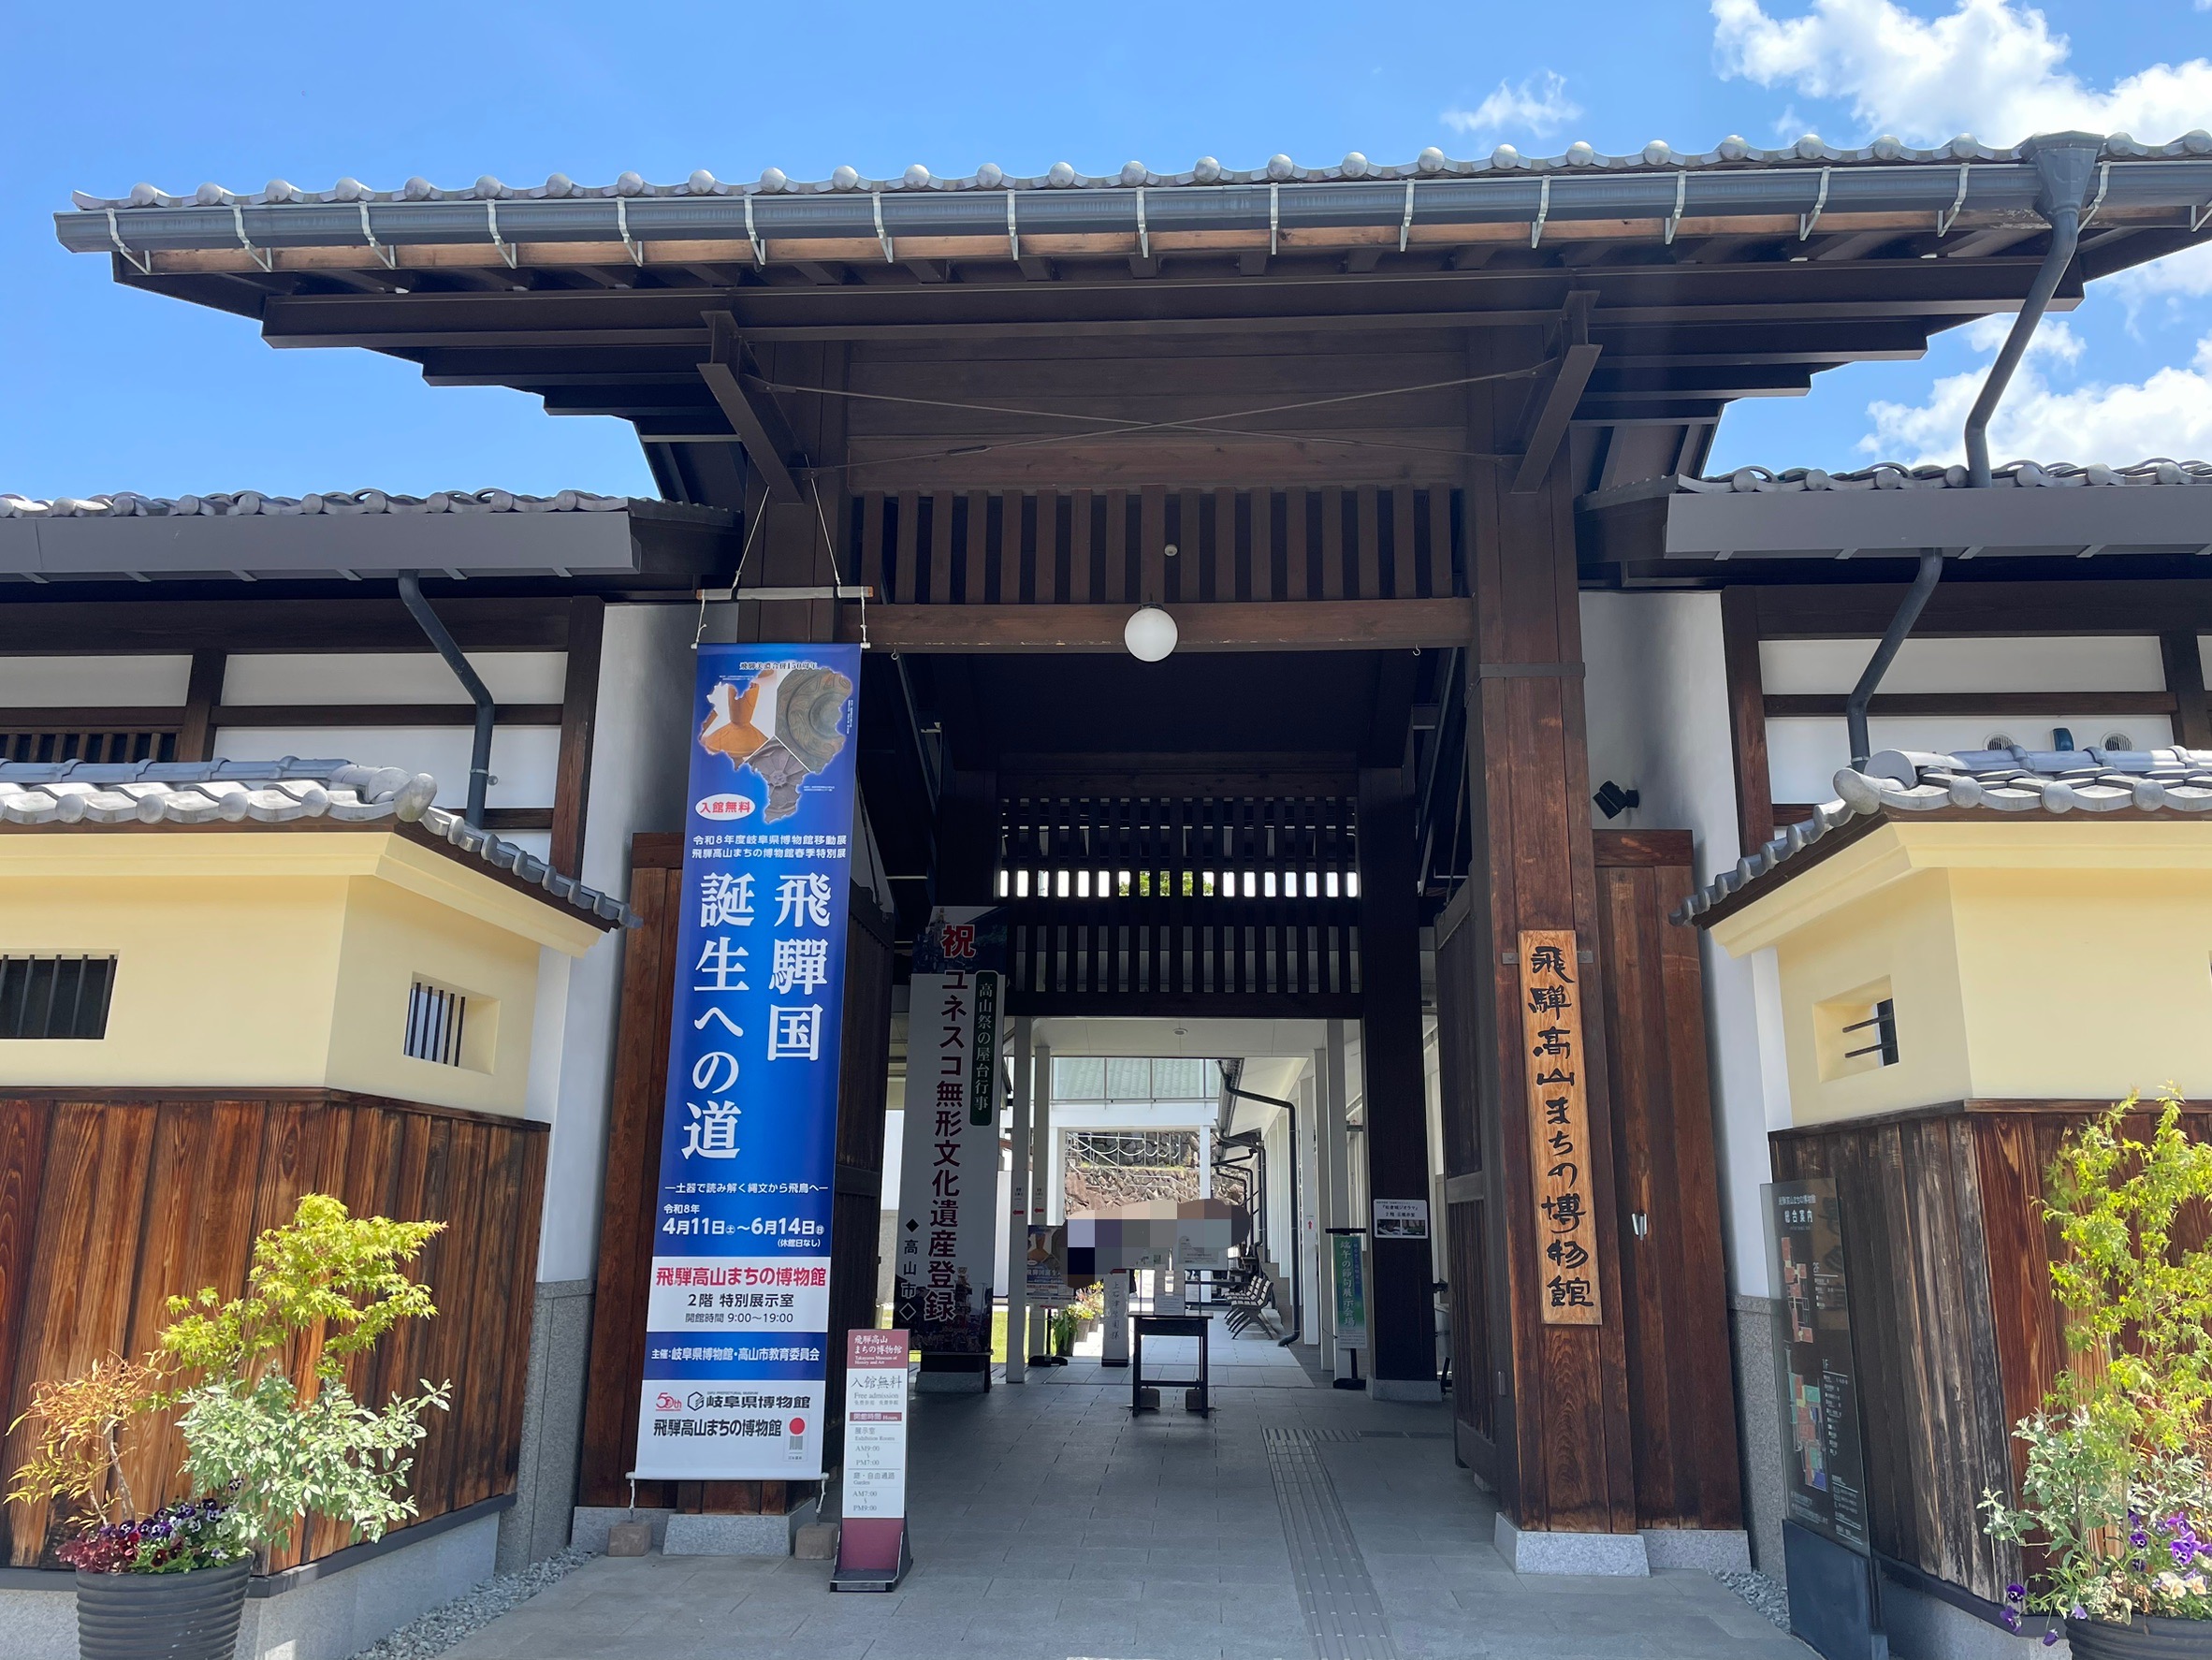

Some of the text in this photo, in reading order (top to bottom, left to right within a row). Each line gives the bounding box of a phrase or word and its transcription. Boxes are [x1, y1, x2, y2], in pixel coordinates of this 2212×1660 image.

[699, 802, 751, 813] 入館無料
[692, 835, 847, 846] 令和8年度岐阜県博物館移動展
[940, 924, 977, 958] 祝
[680, 872, 756, 1160] 誕生への道
[974, 983, 994, 1112] 高山祭の屋台行事
[924, 970, 968, 1321] ユネスコ無形文化遺産登録
[663, 1203, 700, 1215] 令和8年
[901, 1239, 919, 1299] 高山市
[655, 1267, 827, 1287] 飛騨高山まちの博物館
[688, 1293, 794, 1308] 2階 特別展示室
[685, 1313, 724, 1323] 開館時間
[854, 1345, 903, 1355] まちの博物館
[851, 1375, 903, 1390] 入館無料
[706, 1395, 811, 1409] 岐阜県博物館
[653, 1419, 782, 1437] 飛騨高山まちの博物館
